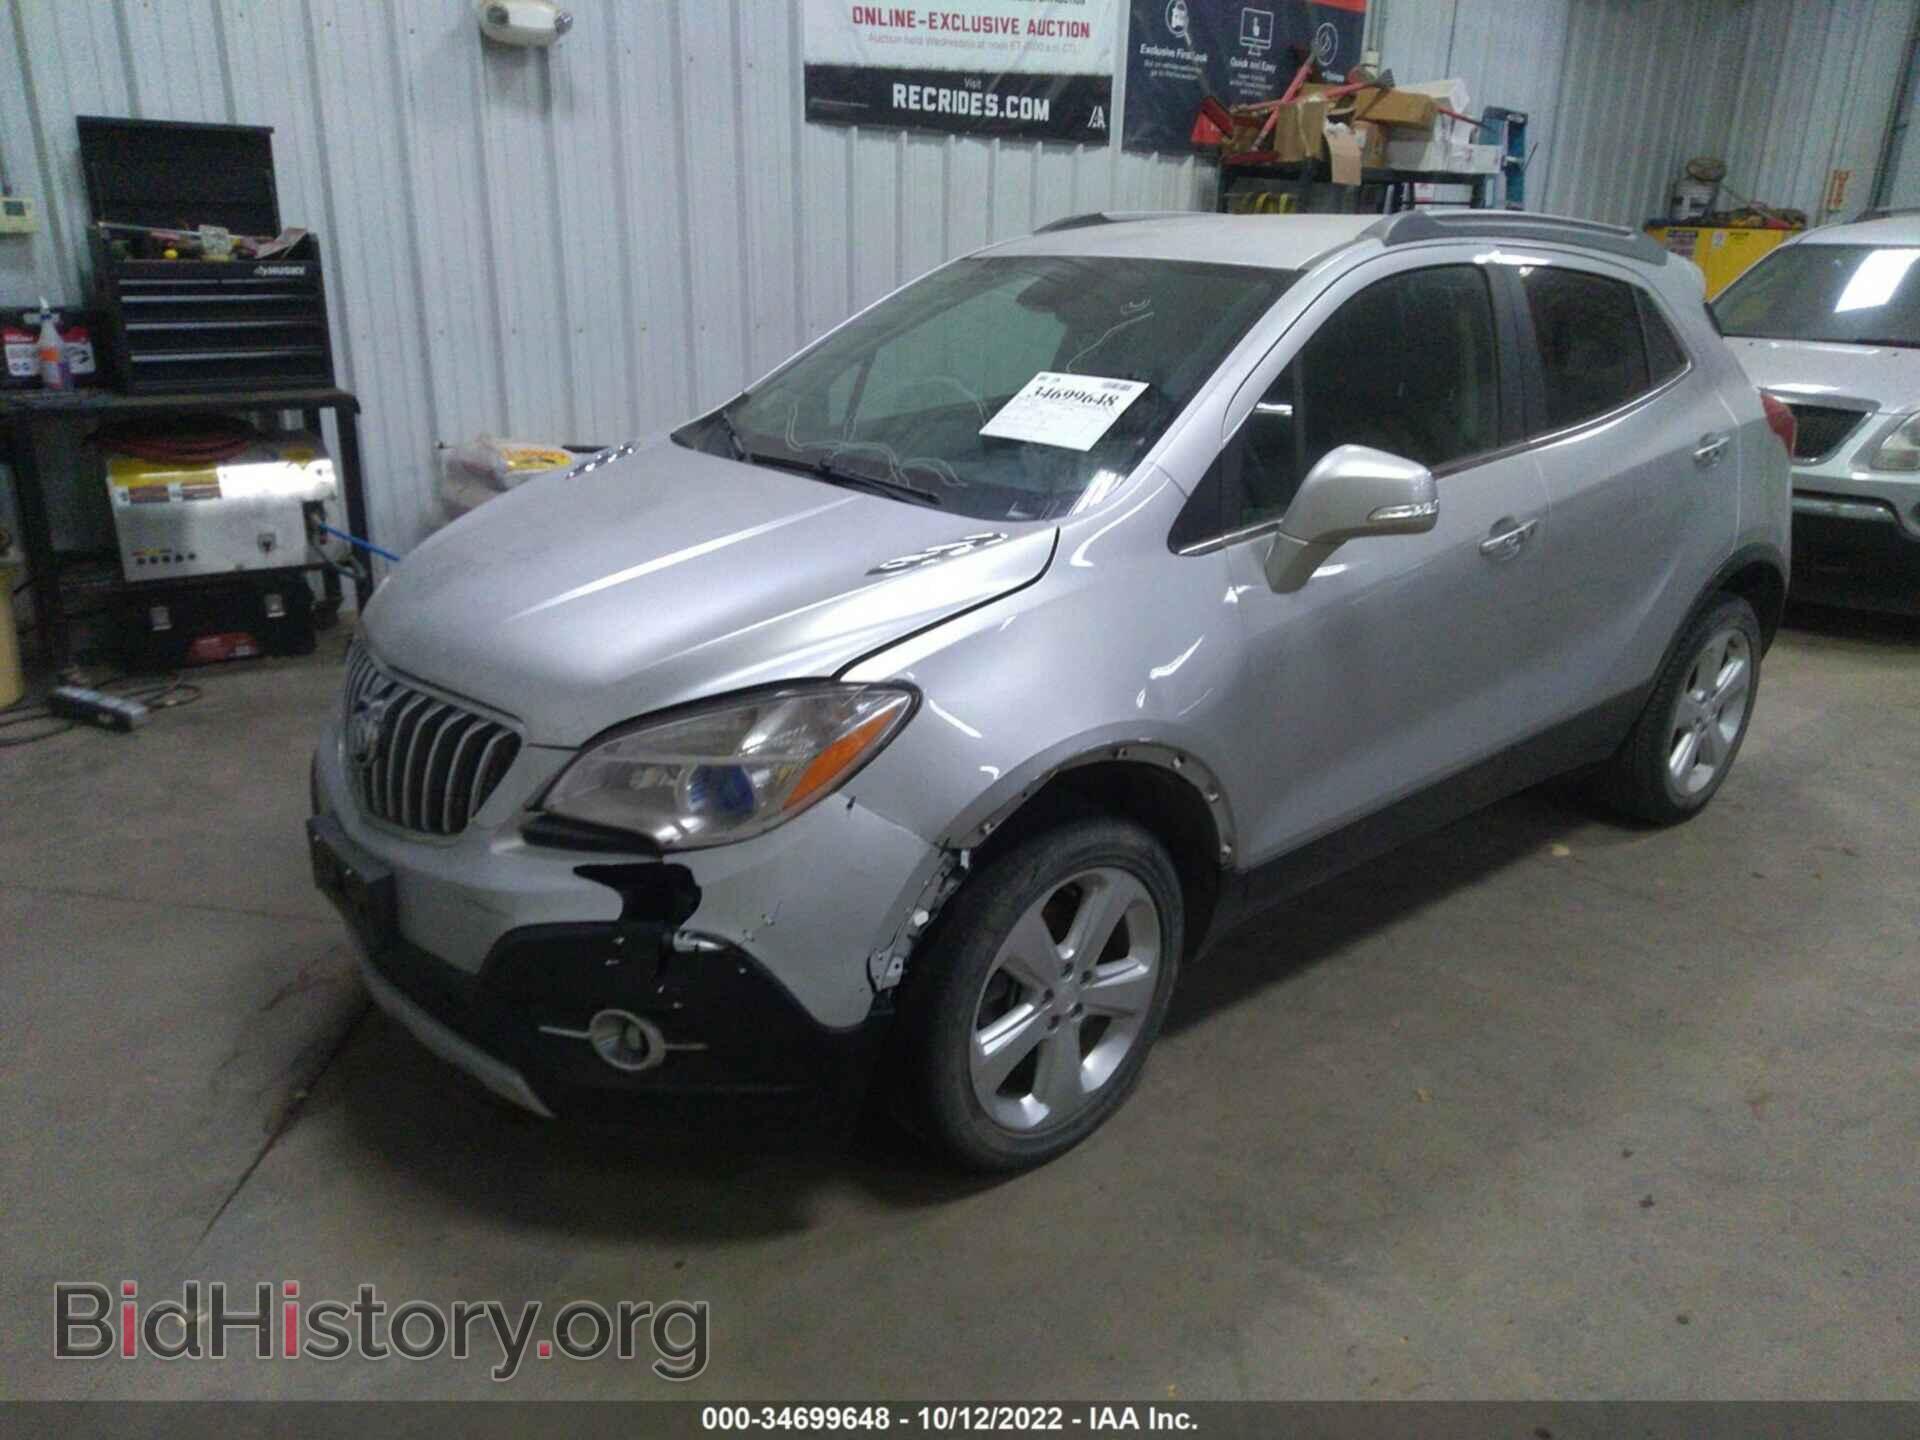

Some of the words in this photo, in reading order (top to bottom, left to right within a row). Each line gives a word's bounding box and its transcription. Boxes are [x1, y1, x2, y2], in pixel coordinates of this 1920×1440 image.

[852, 6, 1020, 36] ONLINE-EXCLUSIVE
[1027, 18, 1091, 39] AUCTION
[892, 82, 1050, 122] RECRIDES.COM
[1034, 385, 1120, 407] 34699648
